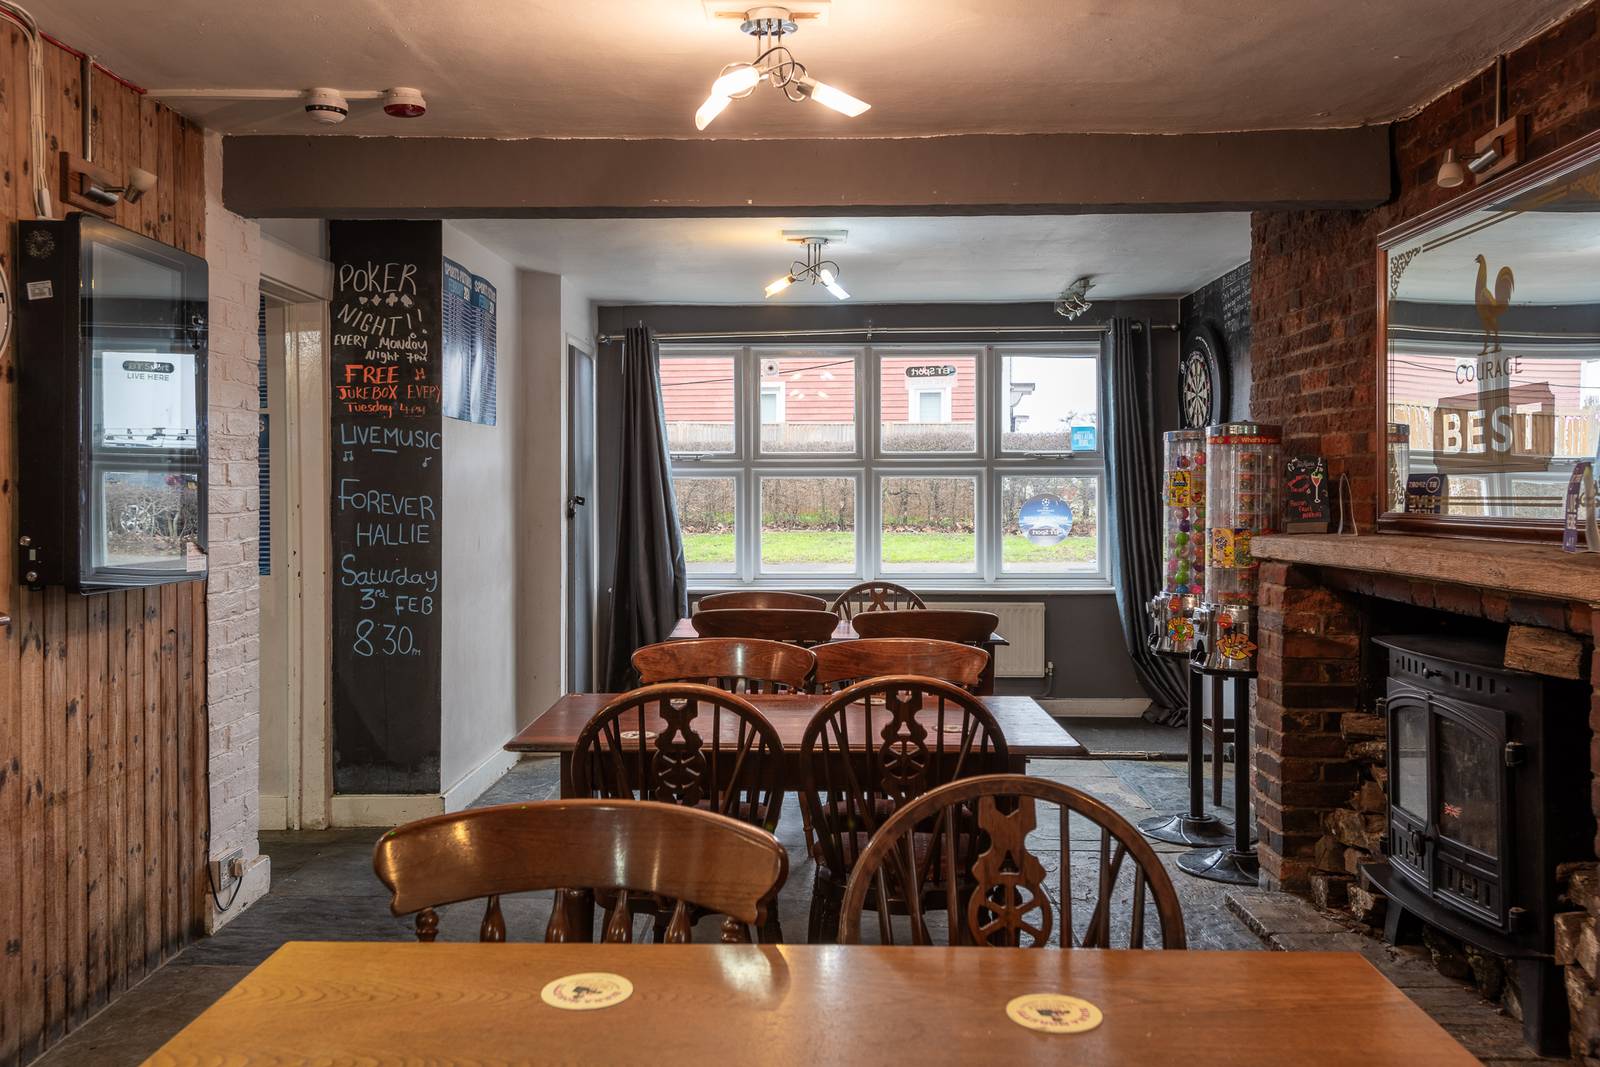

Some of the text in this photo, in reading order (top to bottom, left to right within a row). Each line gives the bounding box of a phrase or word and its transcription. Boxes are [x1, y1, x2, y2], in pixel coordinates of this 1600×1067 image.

[339, 260, 417, 295] POKER
[334, 334, 368, 349] EVERY
[365, 350, 400, 364] Night
[1455, 354, 1523, 385] COURAGE
[344, 364, 401, 384] FREE
[336, 385, 398, 400] JUKEBOX
[343, 401, 393, 418] Tuesday
[341, 423, 441, 450] LIVE MUSIC
[1442, 401, 1543, 455] BEST
[338, 478, 436, 521] FOREVER
[356, 522, 430, 547] HALLIE
[341, 554, 438, 592] Saturday
[394, 595, 433, 616] FEB
